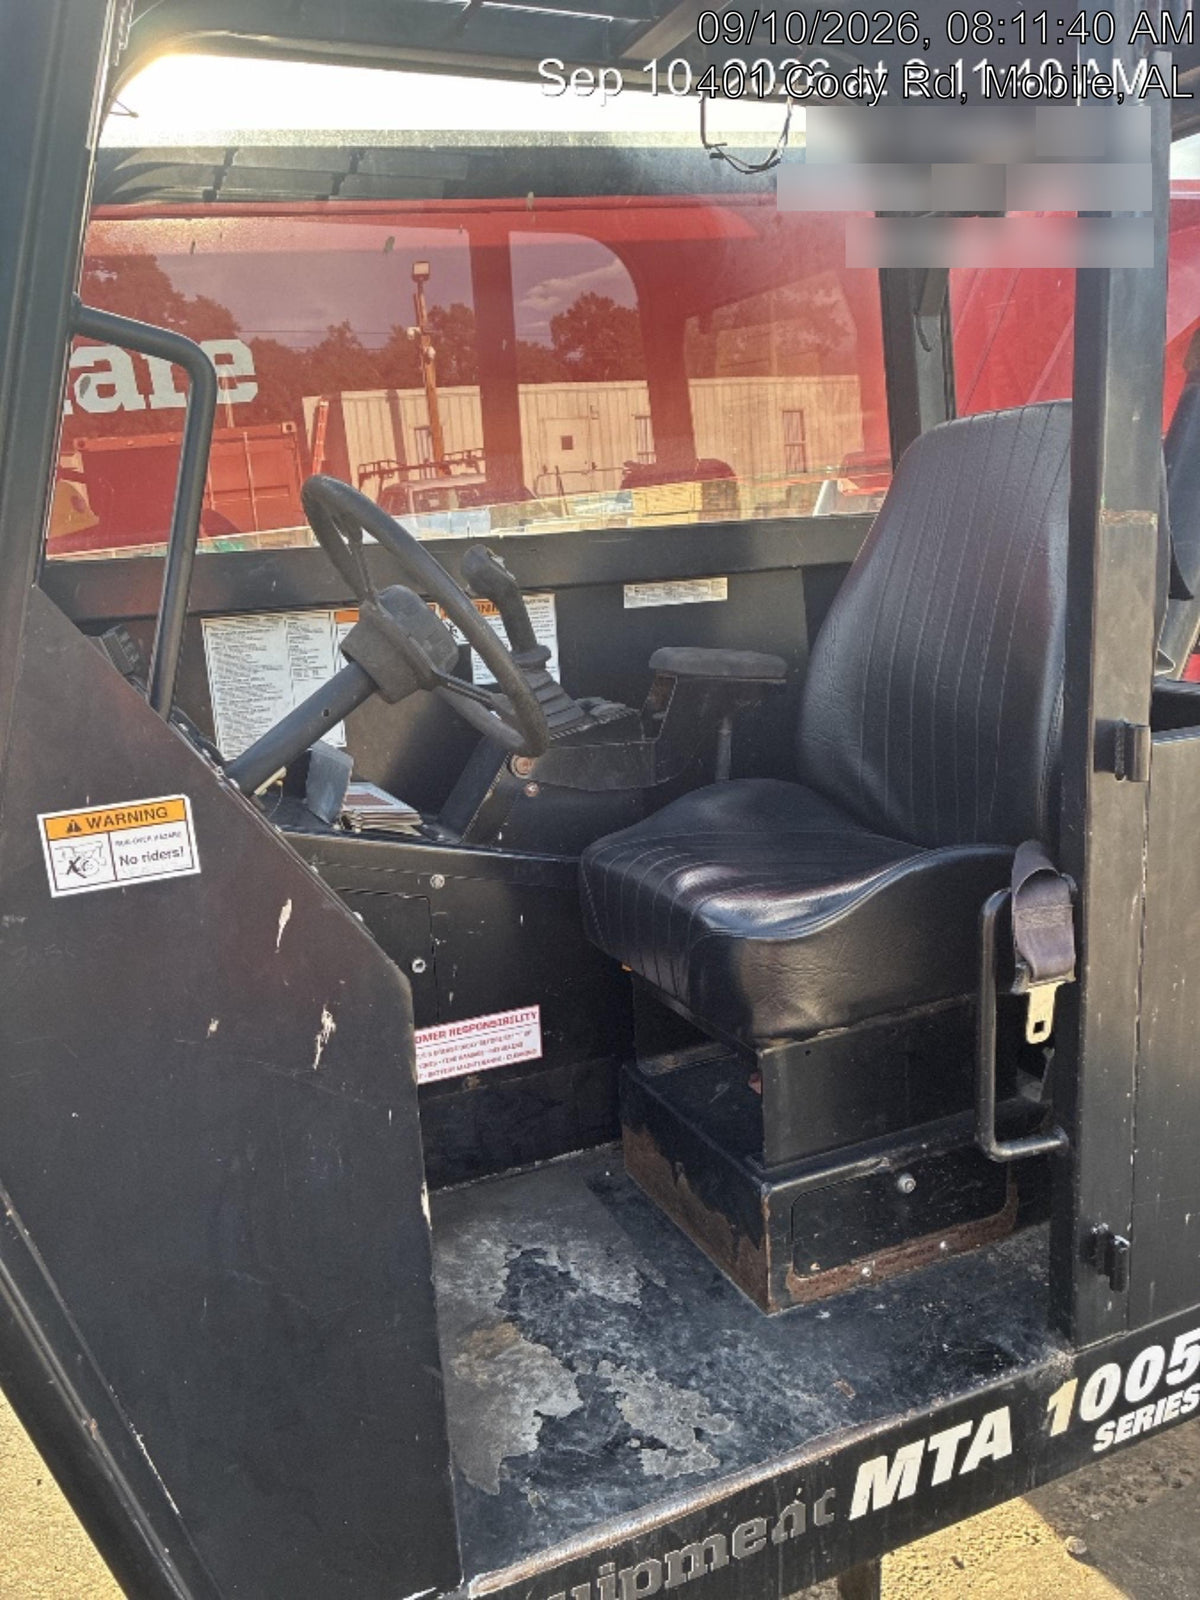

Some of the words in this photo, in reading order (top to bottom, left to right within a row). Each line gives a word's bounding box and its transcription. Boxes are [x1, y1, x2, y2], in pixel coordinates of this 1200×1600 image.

[63, 338, 258, 415] are
[86, 806, 168, 829] WARNING
[119, 854, 138, 867] No
[141, 845, 184, 863] riders!
[449, 1011, 538, 1036] RESPONSIBILITY
[849, 1406, 1012, 1521] MTA
[1047, 1328, 1200, 1437] 1005
[1093, 1383, 1200, 1452] SERIES
